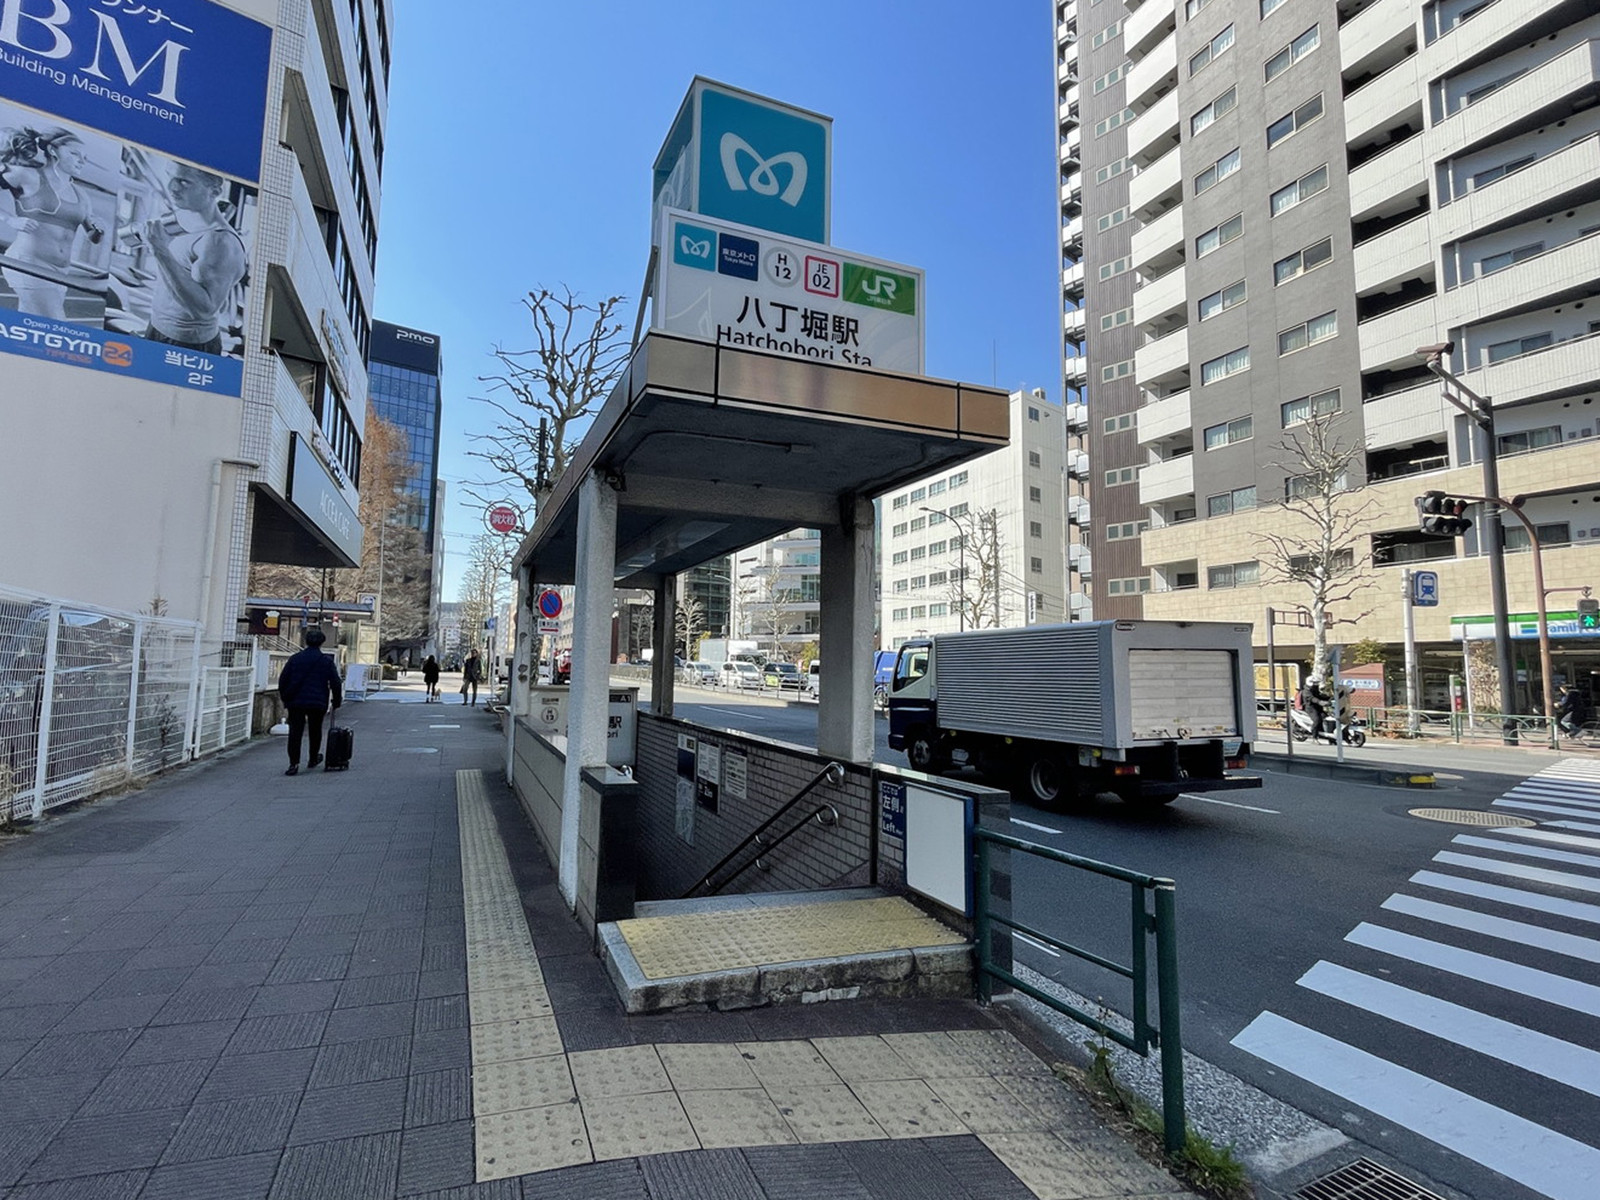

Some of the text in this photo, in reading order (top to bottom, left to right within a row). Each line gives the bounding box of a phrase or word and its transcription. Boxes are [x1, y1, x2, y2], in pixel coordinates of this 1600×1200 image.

[72, 74, 185, 126] Management
[777, 253, 787, 265] H
[775, 266, 791, 280] 12
[816, 263, 828, 275] JE
[812, 275, 831, 290] 02
[862, 274, 896, 300] JR
[23, 317, 90, 339] Open 24hours
[736, 295, 860, 348] 八丁堀駅
[396, 329, 434, 344] pmo
[717, 324, 834, 361] Hatchobori
[164, 350, 214, 371] 当ビル
[188, 372, 213, 386] 2F
[491, 513, 515, 525] 消火栓
[883, 821, 895, 833] Left
